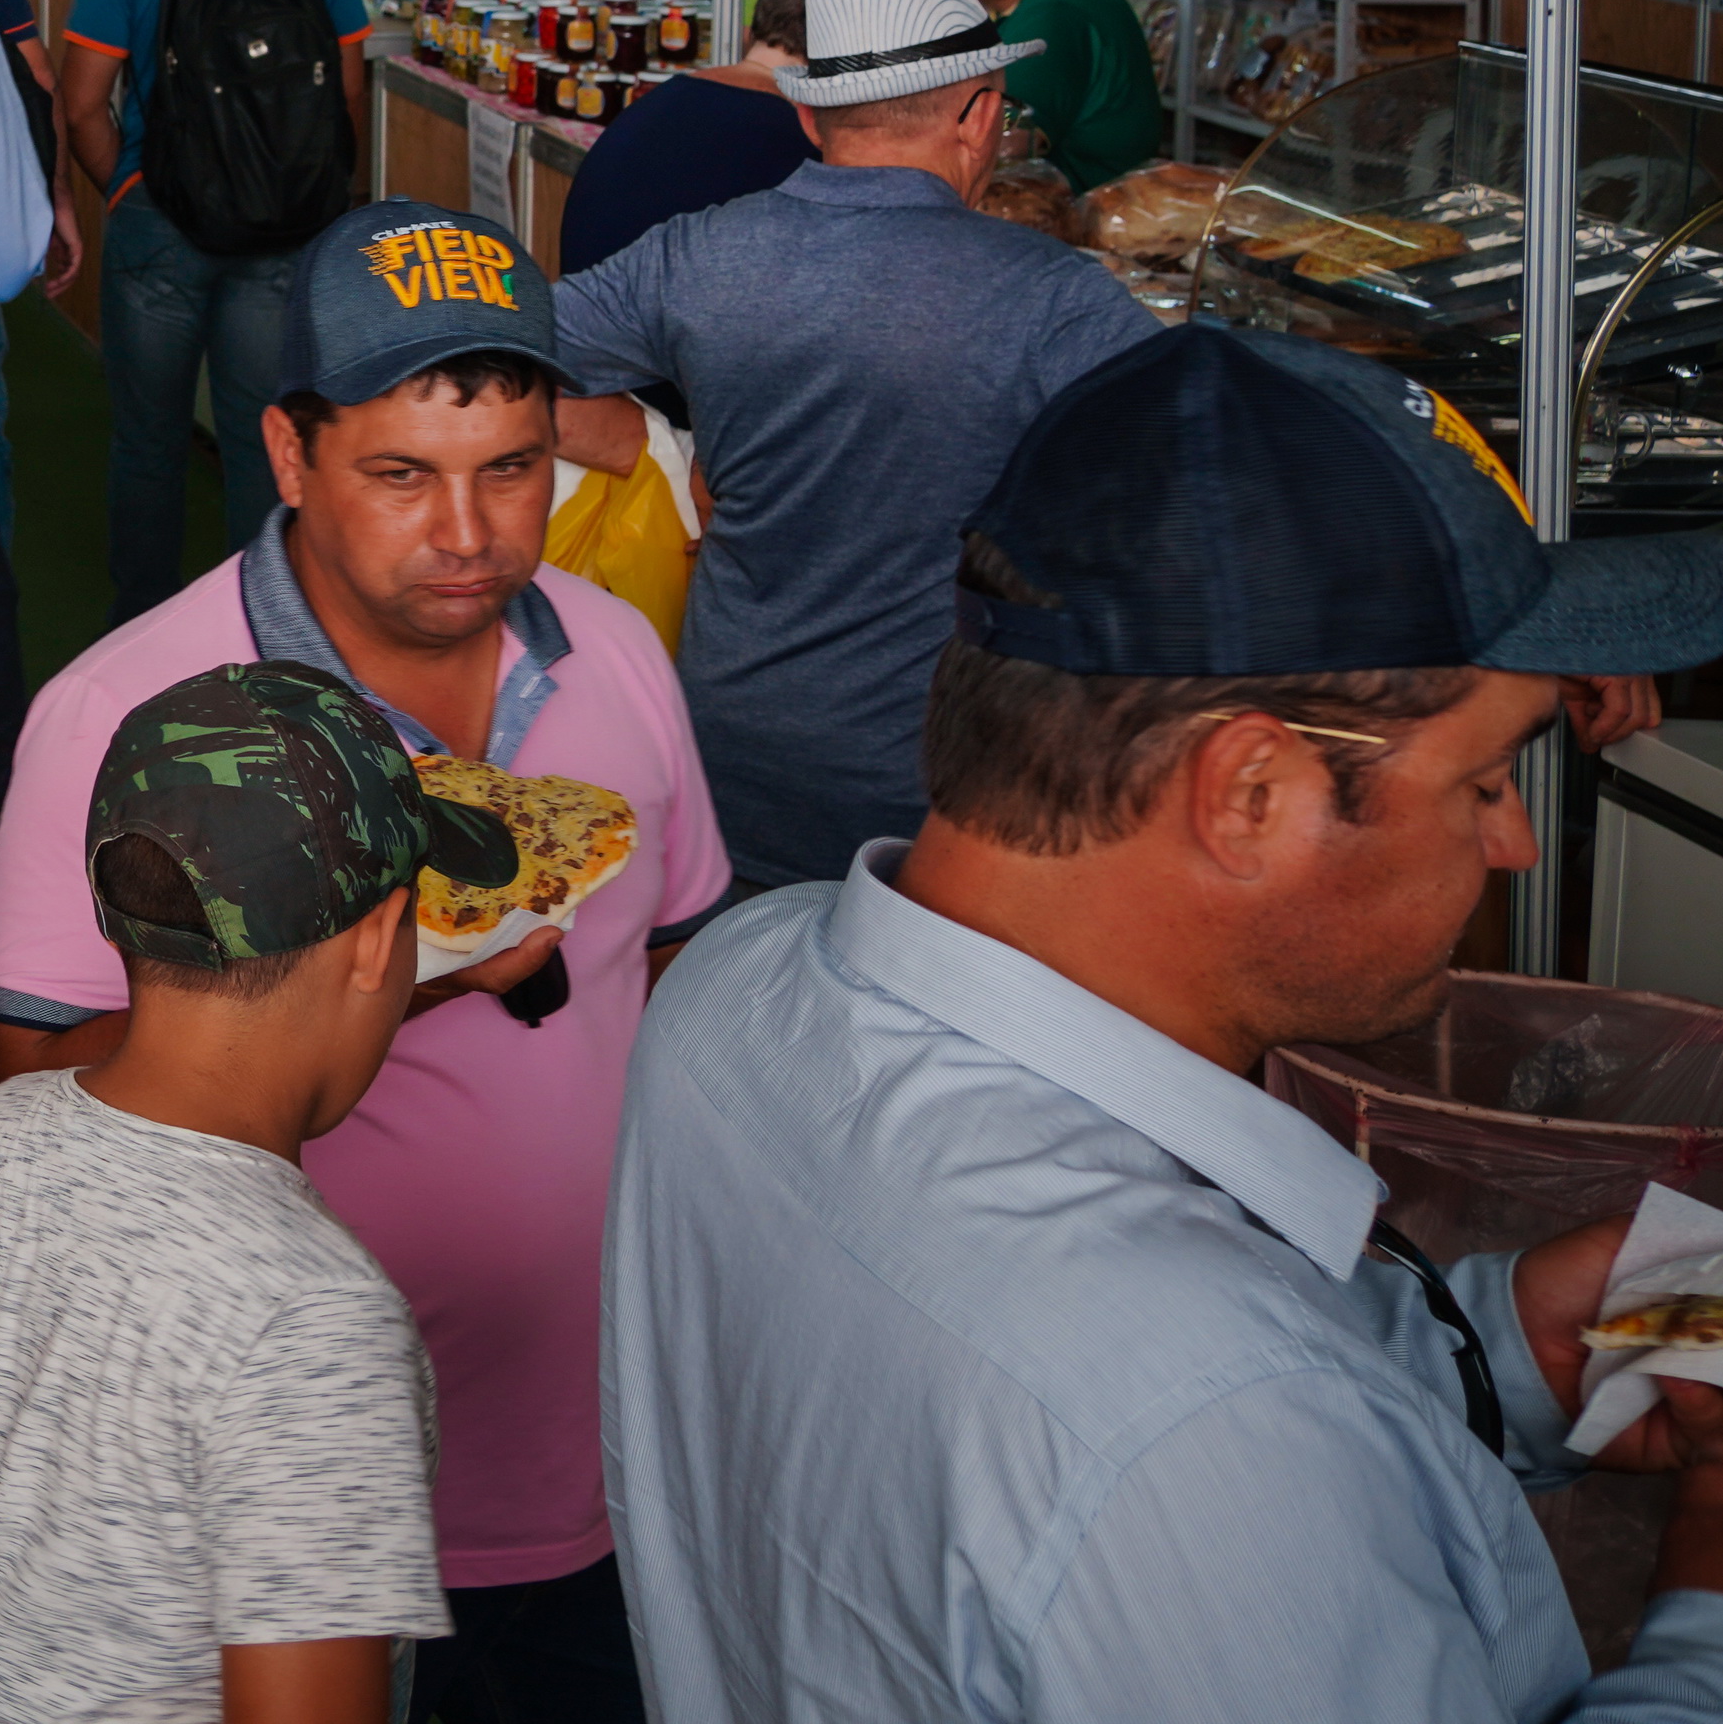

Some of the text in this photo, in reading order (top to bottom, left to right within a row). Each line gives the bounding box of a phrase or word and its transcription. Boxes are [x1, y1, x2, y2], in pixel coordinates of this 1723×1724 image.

[362, 228, 515, 274] FIELD
[371, 220, 457, 241] CLIMATE
[383, 260, 520, 312] VIEW
